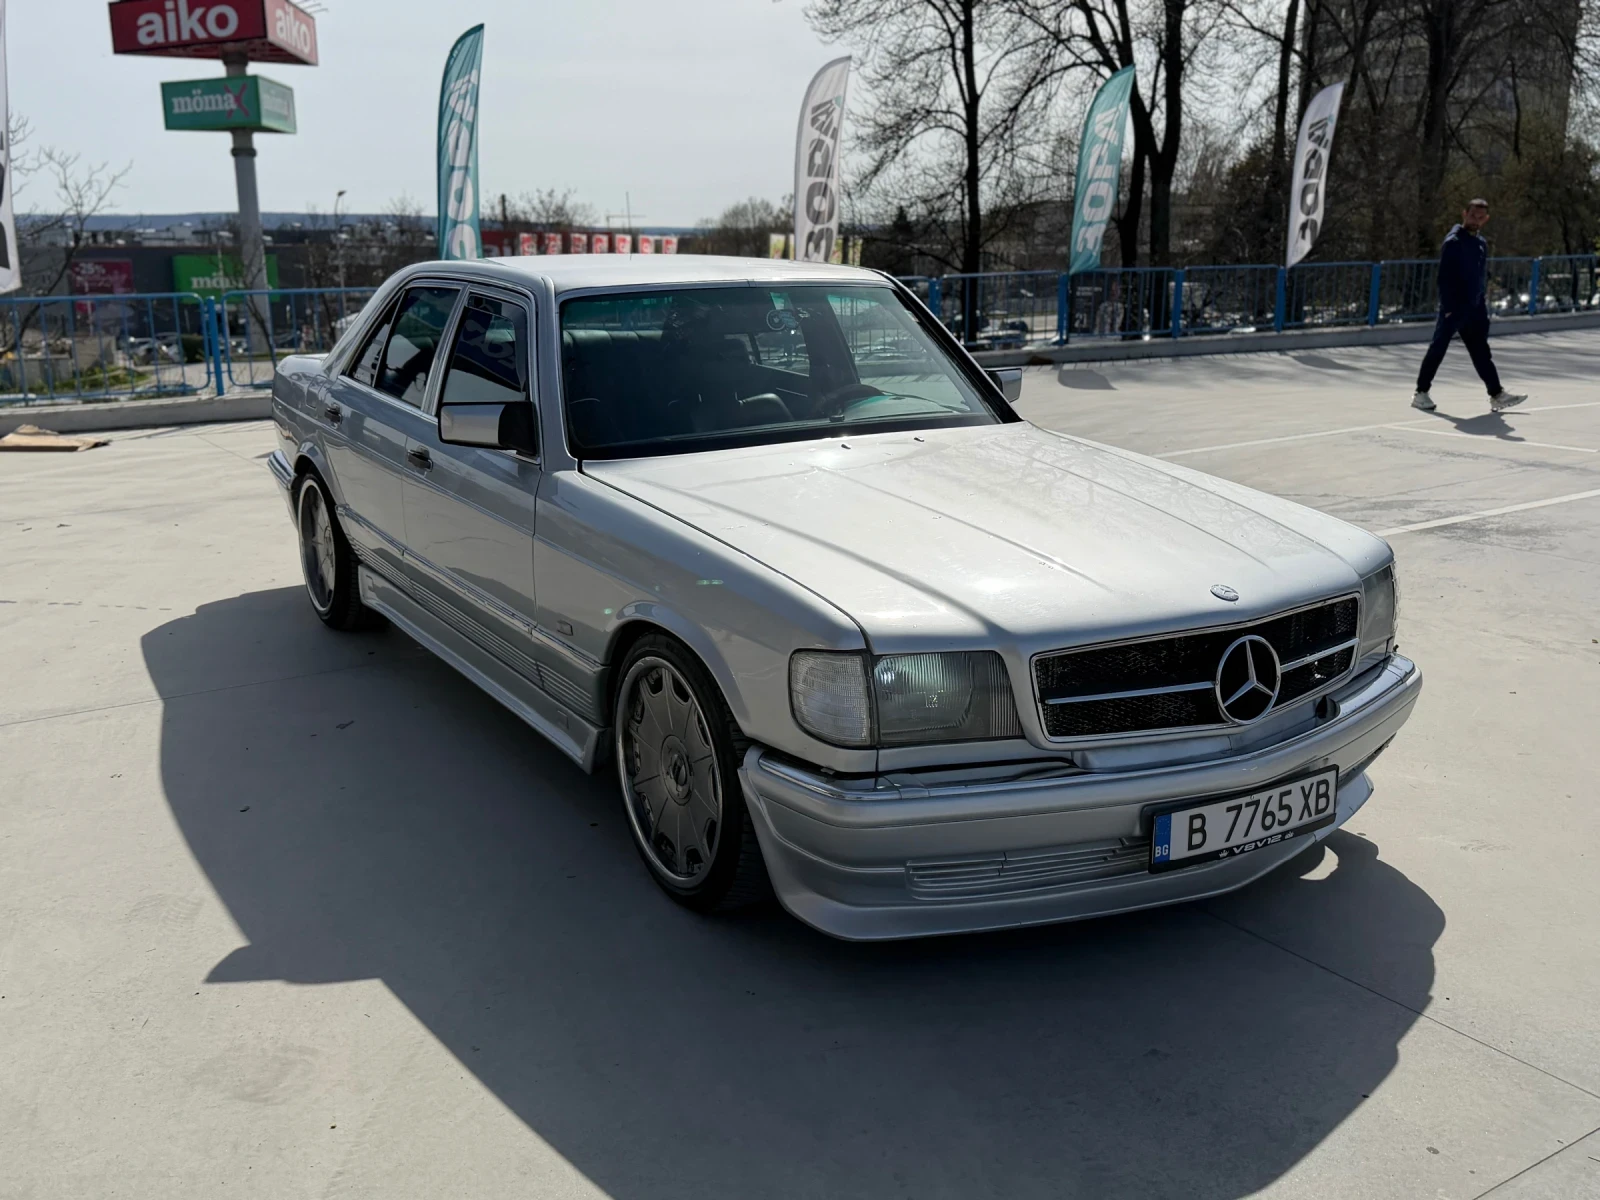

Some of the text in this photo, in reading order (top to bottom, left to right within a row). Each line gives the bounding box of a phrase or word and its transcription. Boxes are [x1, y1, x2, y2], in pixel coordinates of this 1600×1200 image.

[137, 0, 238, 45] aiko
[275, 4, 311, 54] aiko
[1187, 779, 1331, 851] B 7765 XB
[1155, 844, 1169, 857] BG
